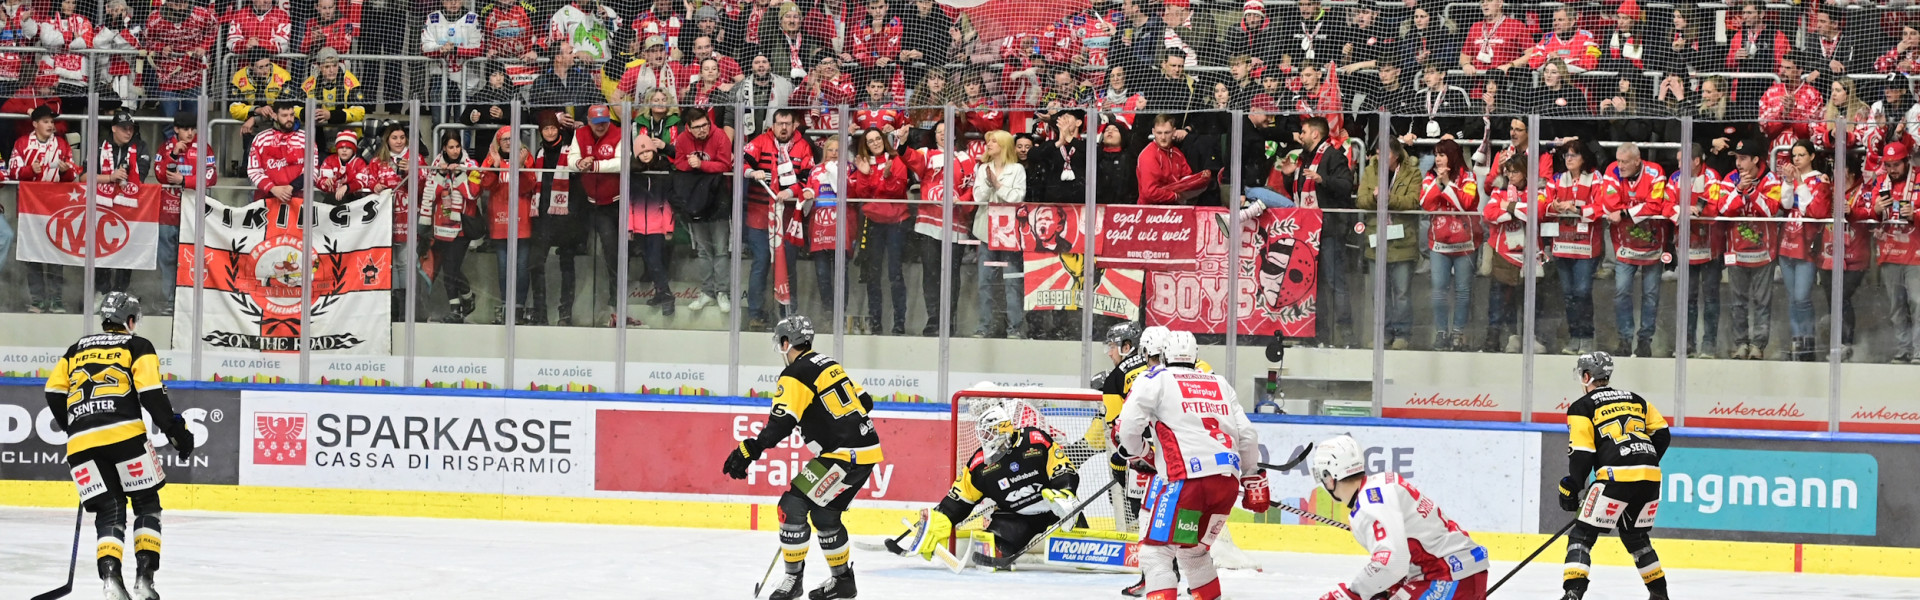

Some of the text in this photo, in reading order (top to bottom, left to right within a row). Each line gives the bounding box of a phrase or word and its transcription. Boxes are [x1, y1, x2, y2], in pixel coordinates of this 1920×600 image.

[1113, 208, 1184, 224] egal wohin
[55, 208, 120, 255] KAC
[1106, 226, 1191, 246] egal wie weit
[1152, 271, 1257, 322] BOYS
[228, 335, 251, 348] ON
[255, 336, 289, 350] THE
[1188, 388, 1217, 398] Fairplay
[1406, 392, 1500, 409] intercable
[73, 400, 115, 416] SENFTER
[1181, 401, 1229, 416] PETERSEN
[1709, 402, 1805, 419] intercable
[315, 412, 572, 455] SPARKASSE
[315, 450, 571, 475] CASSA DI RISPARMIO
[1009, 469, 1039, 483] Volksbank
[814, 471, 840, 499] GERAX
[1177, 518, 1199, 532] kela
[1372, 519, 1387, 542] 6
[1050, 539, 1124, 558] KRONPLATZ
